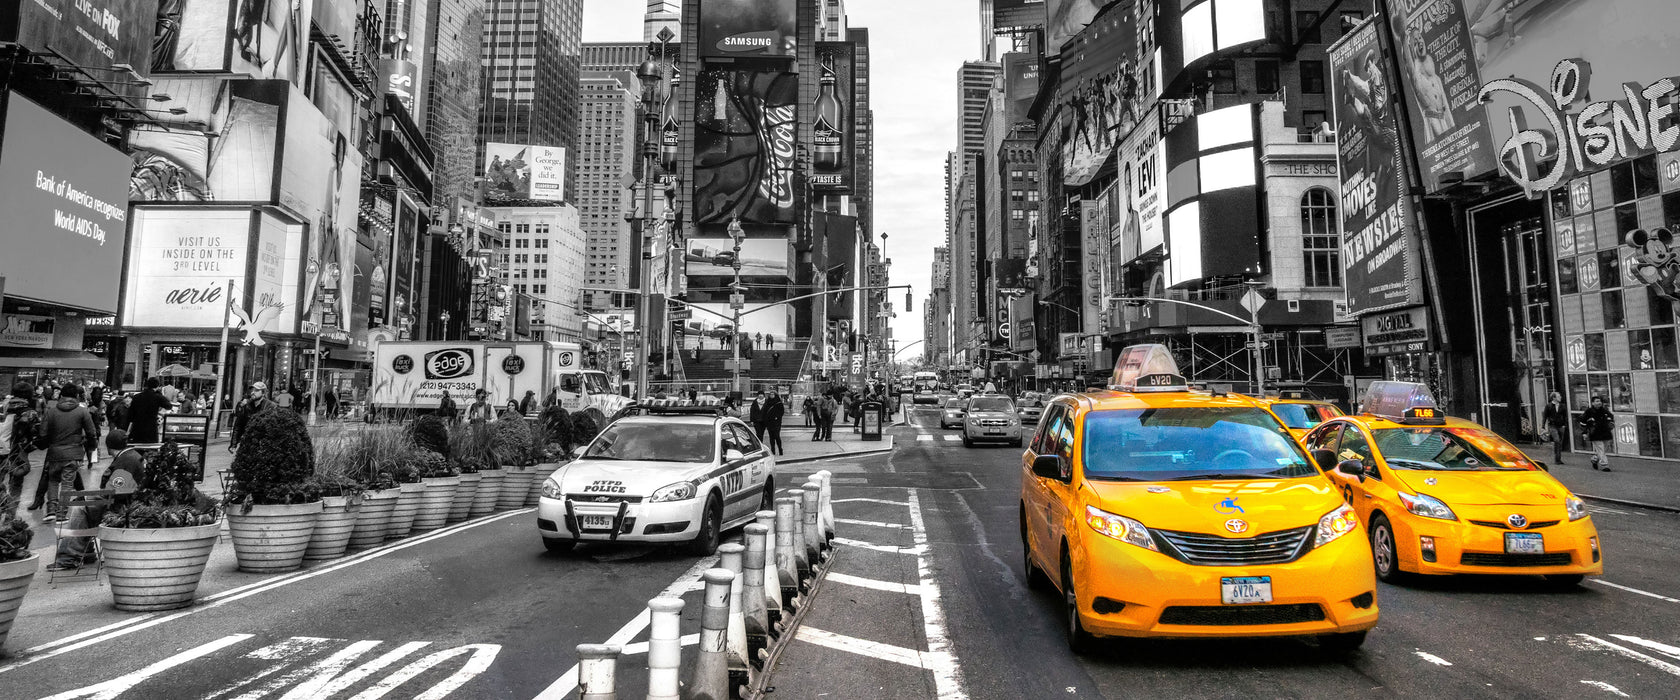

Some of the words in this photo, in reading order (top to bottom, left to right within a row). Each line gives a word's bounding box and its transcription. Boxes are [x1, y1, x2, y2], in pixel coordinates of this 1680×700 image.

[92, 7, 102, 26] ON
[102, 7, 121, 41] FOX
[724, 37, 772, 46] SAMSUNG
[1450, 73, 1475, 97] ORIGINAL
[535, 157, 562, 166] George,
[544, 150, 553, 158] By
[538, 171, 549, 179] did
[1138, 152, 1156, 198] LEVI
[1287, 164, 1309, 174] THE
[1313, 164, 1337, 174] SHO
[835, 175, 842, 183] IS
[1342, 167, 1364, 198] NOTHING
[36, 169, 56, 194] Bank
[56, 180, 67, 197] of
[65, 183, 94, 209] America
[93, 198, 125, 222] recognizes
[1342, 171, 1377, 222] MOVES
[1364, 199, 1377, 220] LIKE
[54, 208, 76, 232] World
[75, 217, 93, 238] AIDS
[92, 223, 106, 247] Day.
[178, 236, 204, 247] VISIT
[208, 236, 221, 247] US
[162, 249, 195, 259] INSIDE
[200, 249, 213, 259] ON
[217, 249, 234, 259] THE
[1087, 208, 1099, 306] PALACE
[173, 261, 189, 271] 3RD
[192, 261, 220, 271] LEVEL
[1367, 258, 1376, 275] ON
[165, 281, 221, 304] aerie
[1377, 313, 1411, 332] DIGITAL
[1408, 343, 1424, 351] SONY
[434, 356, 465, 374] edge
[852, 354, 863, 375] tkts
[437, 382, 477, 391] 947-3343
[1414, 409, 1434, 418] 7L66
[584, 485, 627, 493] POLICE
[725, 469, 744, 496] NYPD
[584, 515, 605, 526] 4135
[1233, 584, 1254, 598] 6V20
[1254, 590, 1261, 598] A
